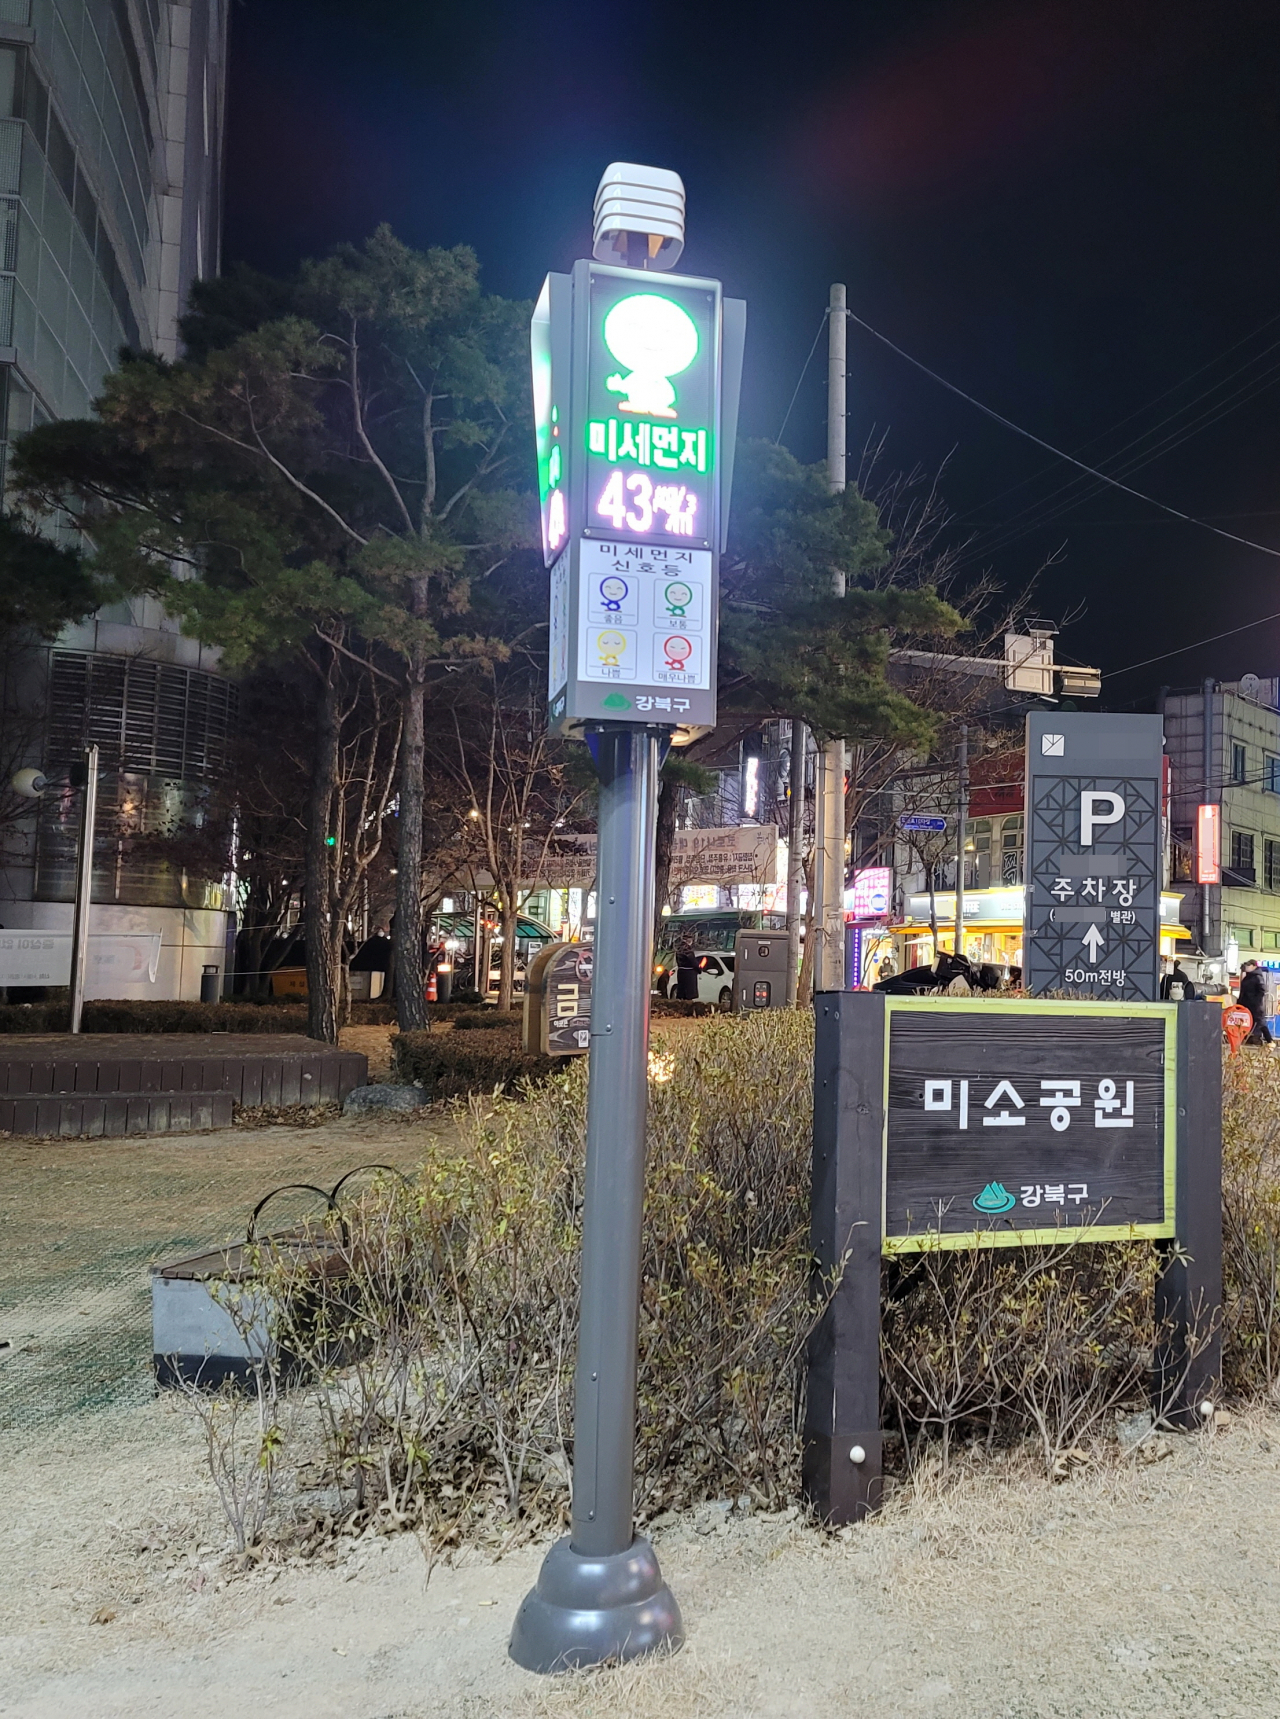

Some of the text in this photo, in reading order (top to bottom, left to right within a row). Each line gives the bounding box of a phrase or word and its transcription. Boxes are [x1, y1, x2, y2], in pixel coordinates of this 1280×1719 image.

[589, 418, 707, 472] 미세먼지
[597, 470, 653, 532] 43
[600, 544, 693, 564] 미세먼지
[611, 560, 682, 577] 신호등
[604, 614, 623, 625] 좋음
[669, 620, 688, 630] 보통
[601, 668, 621, 678] 나쁨
[635, 695, 691, 713] 강북구
[1080, 790, 1126, 846] P
[1050, 877, 1137, 907] 주차장
[1110, 910, 1136, 924] 별관)
[1064, 969, 1127, 987] 50m전방
[924, 1078, 1134, 1132] 미소공원
[1020, 1183, 1089, 1207] 강북구
